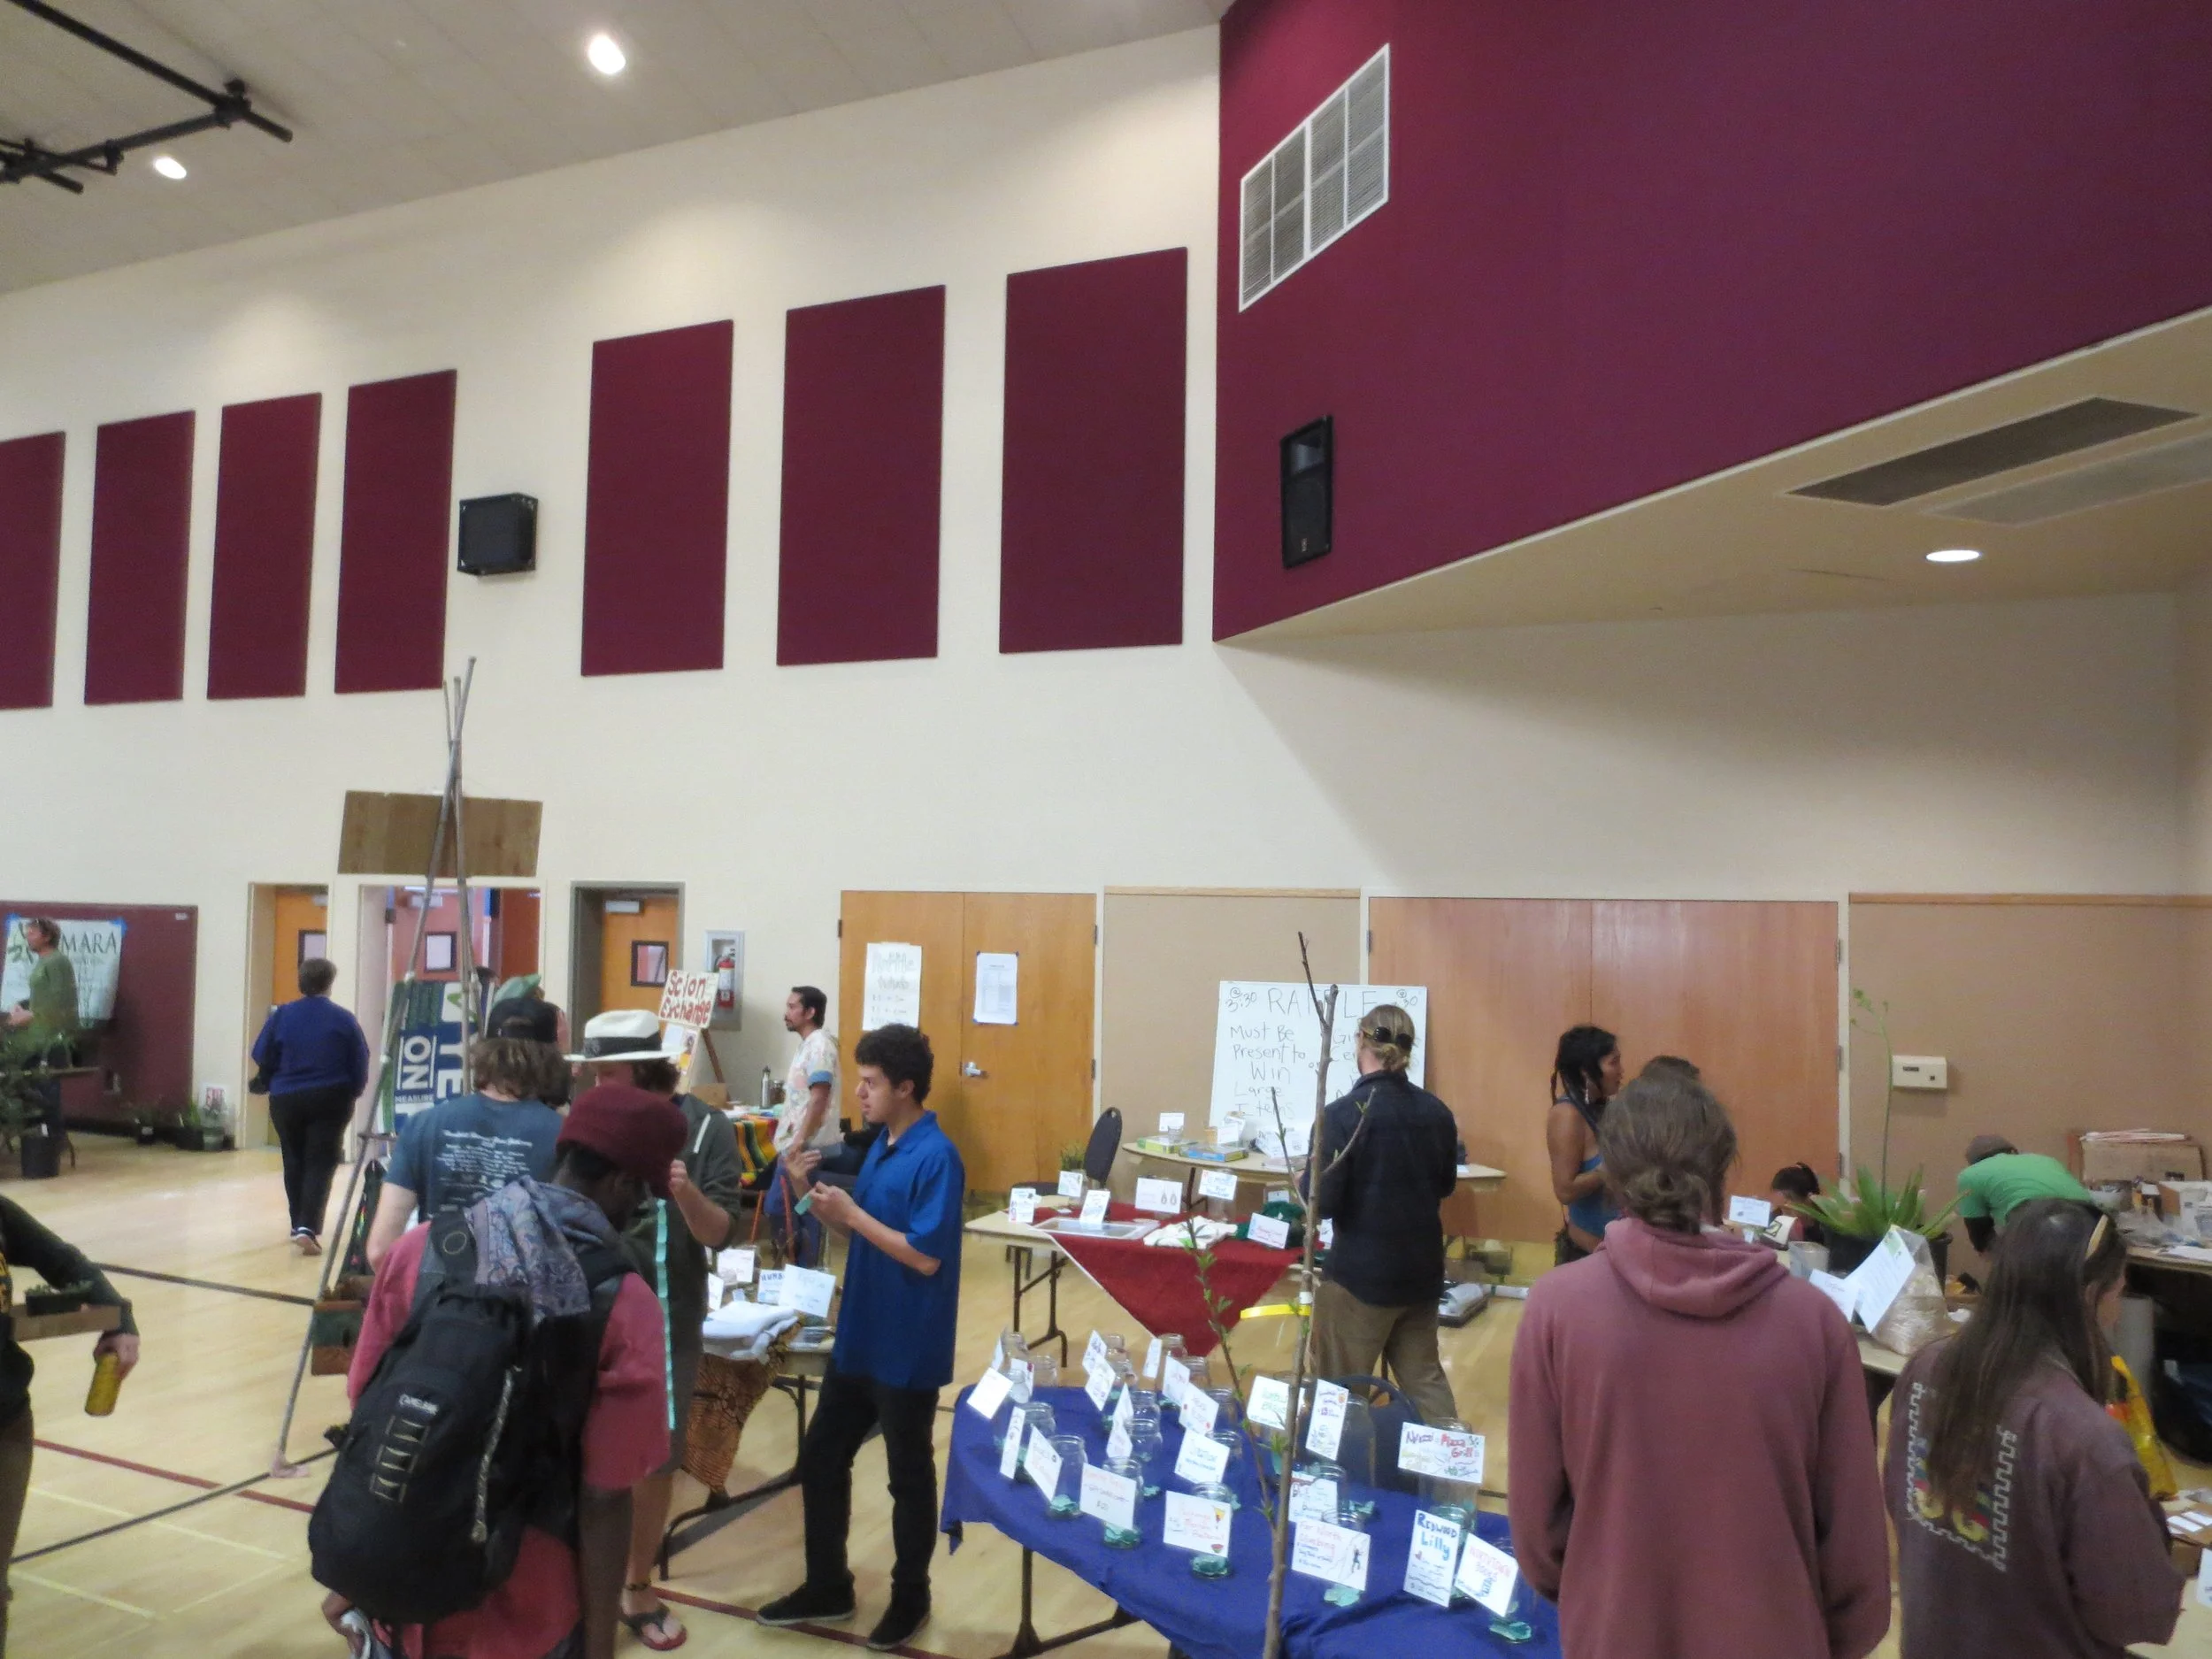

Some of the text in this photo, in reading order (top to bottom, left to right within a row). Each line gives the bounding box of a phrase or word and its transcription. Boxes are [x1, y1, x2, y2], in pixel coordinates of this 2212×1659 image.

[668, 970, 707, 998] Scion
[660, 996, 711, 1025] Exchange
[1230, 1021, 1294, 1042] Must Be
[1233, 1043, 1306, 1064] Present to
[1249, 1060, 1292, 1084] Win
